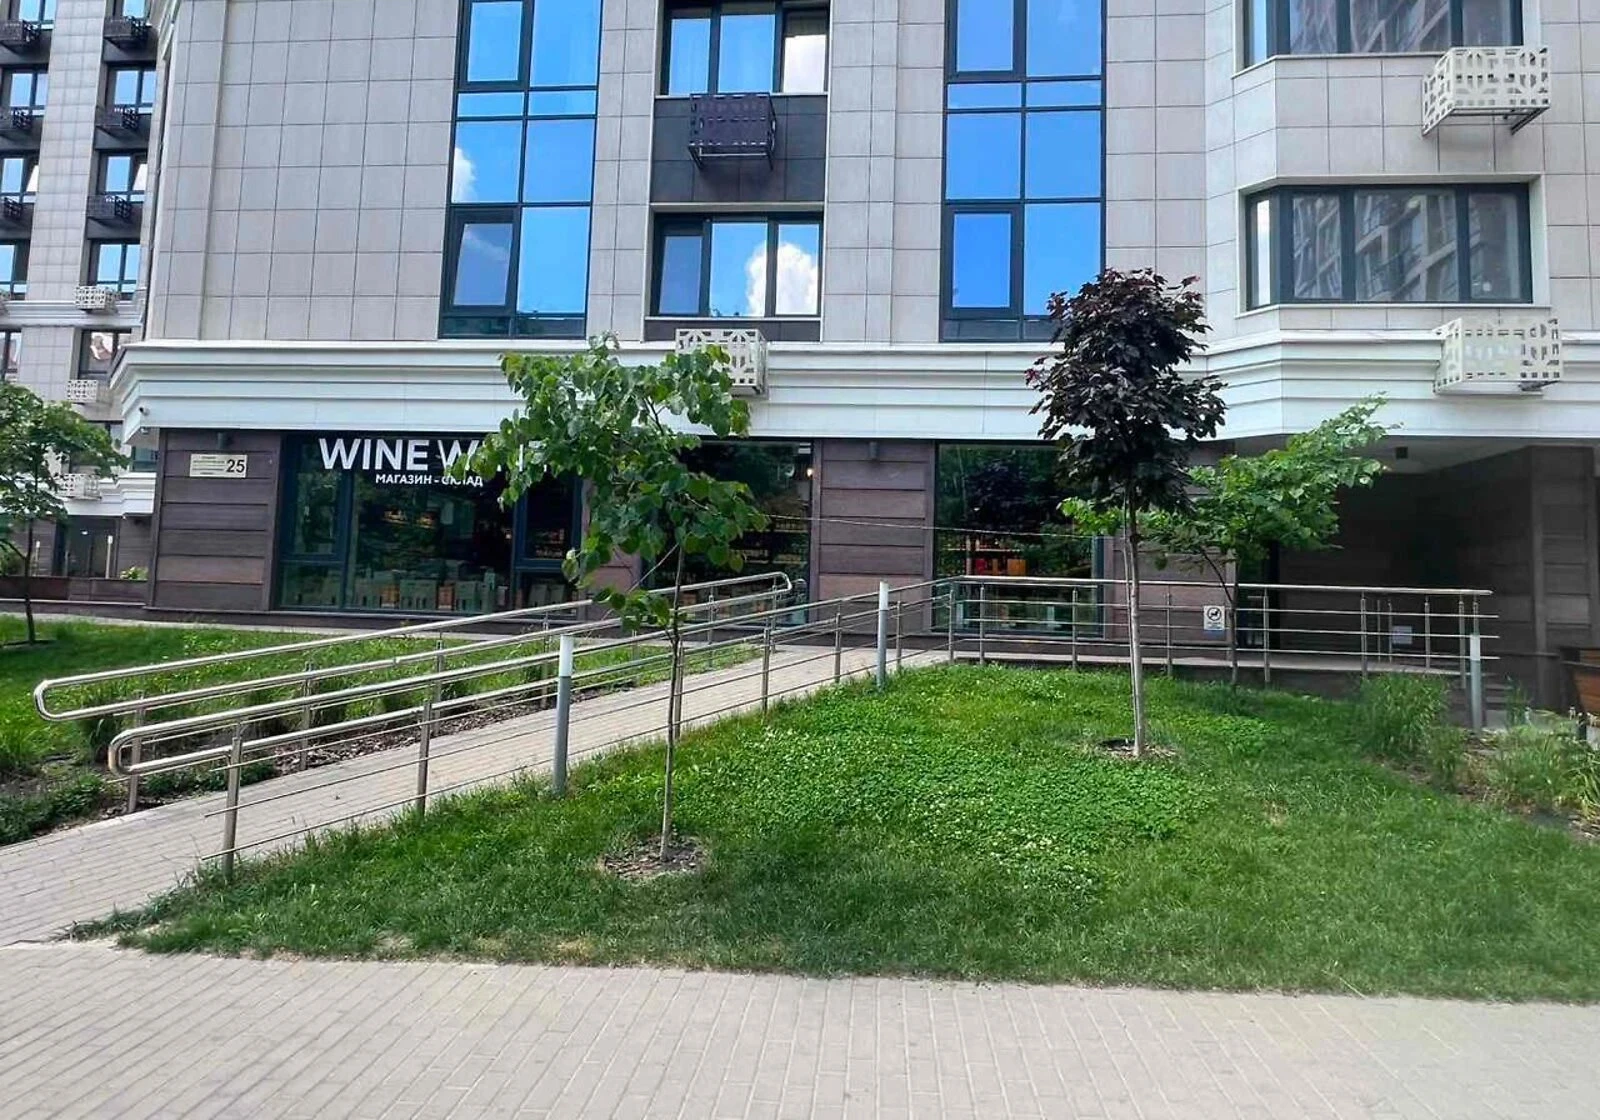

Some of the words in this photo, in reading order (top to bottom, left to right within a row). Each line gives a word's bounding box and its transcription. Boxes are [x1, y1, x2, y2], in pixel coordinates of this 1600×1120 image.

[319, 438, 430, 471] WINE
[226, 458, 245, 473] 25
[374, 473, 432, 485] МАГАЗИН
